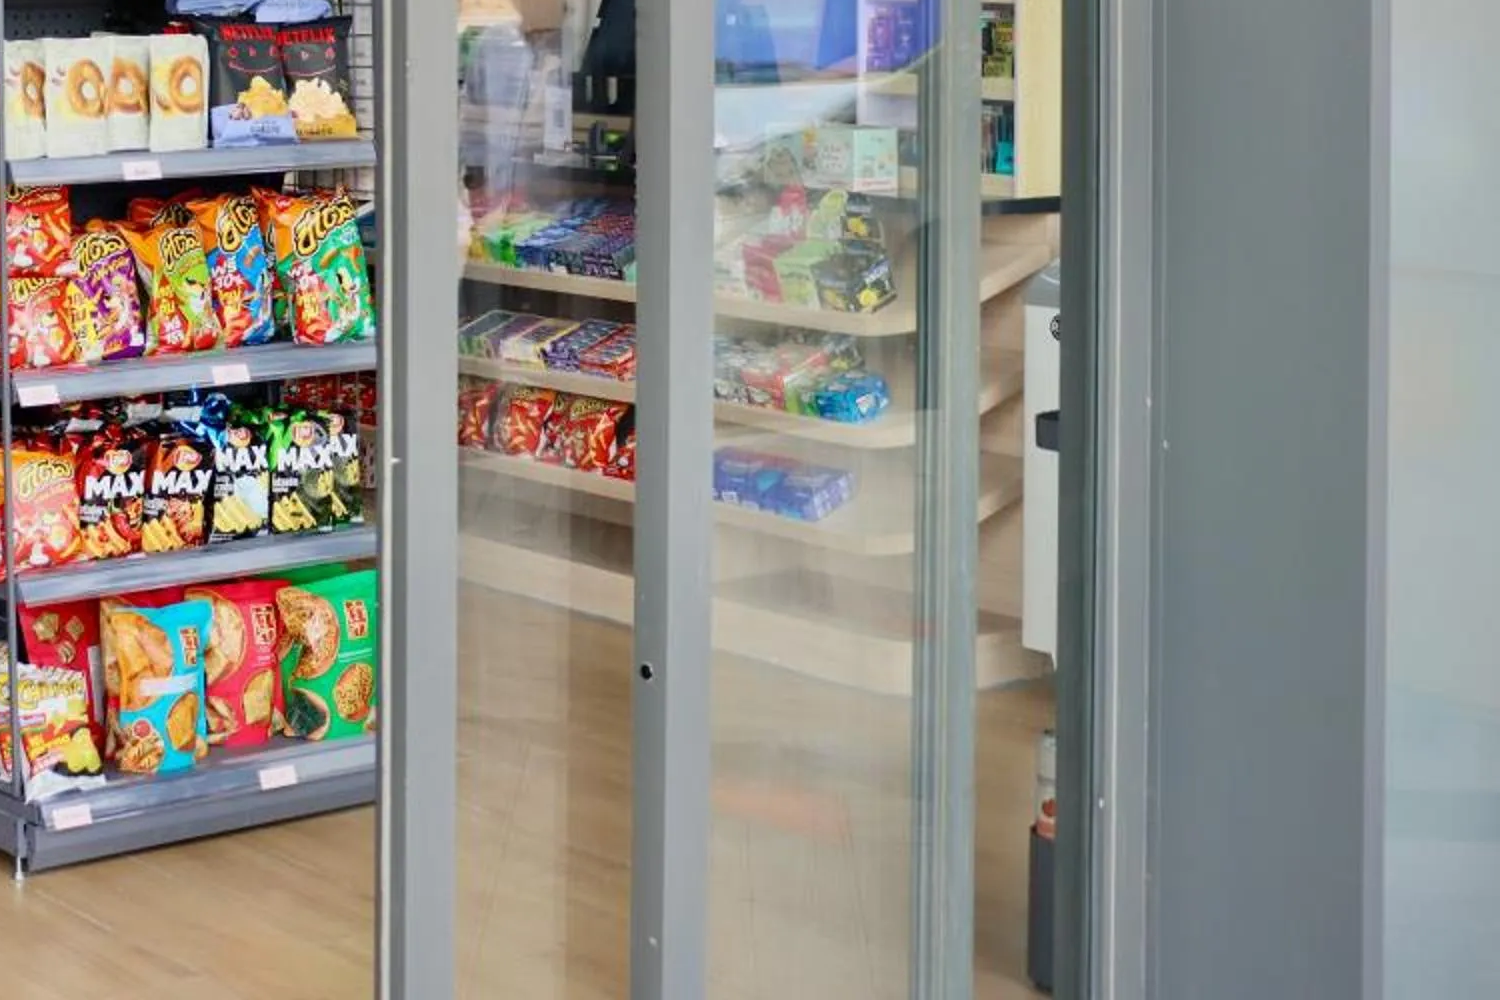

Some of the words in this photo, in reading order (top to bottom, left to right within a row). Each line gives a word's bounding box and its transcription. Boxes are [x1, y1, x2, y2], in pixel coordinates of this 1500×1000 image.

[215, 443, 269, 473] MAX
[277, 443, 334, 472] MAX
[85, 470, 145, 500] MAX
[151, 469, 213, 495] MAX
